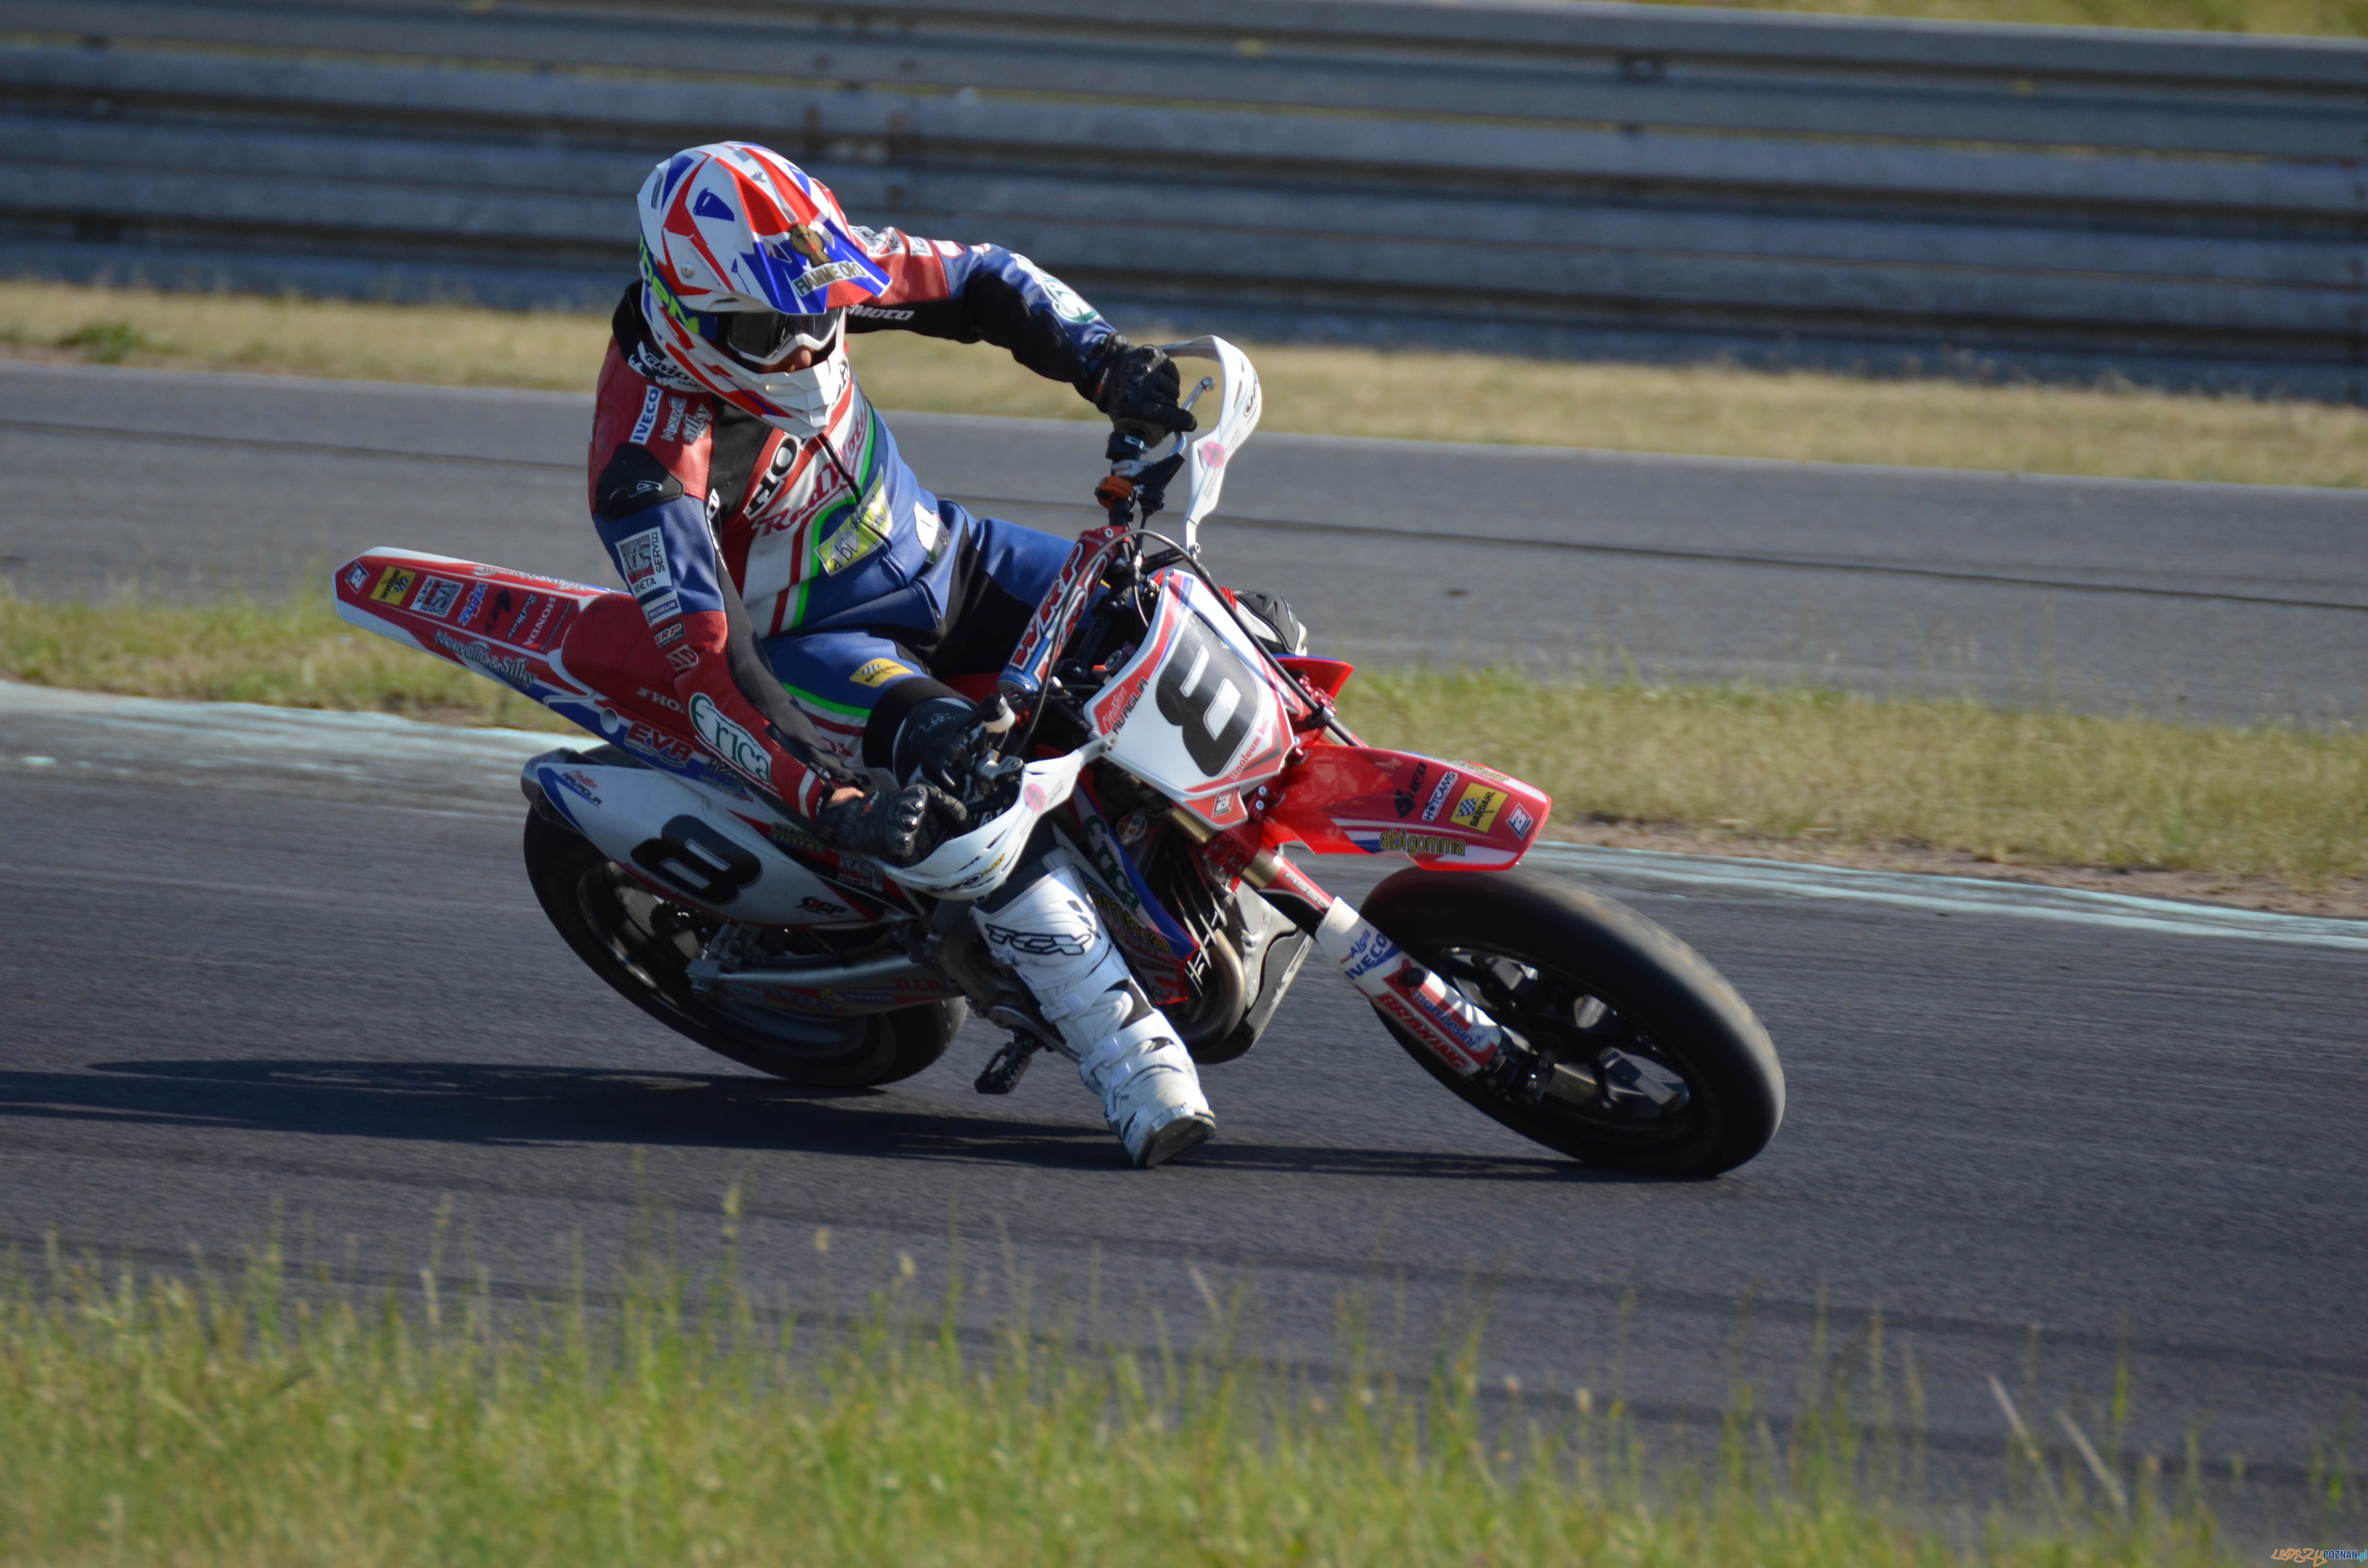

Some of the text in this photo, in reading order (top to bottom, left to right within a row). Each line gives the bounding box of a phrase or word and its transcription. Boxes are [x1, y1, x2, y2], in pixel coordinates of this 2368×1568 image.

[794, 265, 842, 295] FIAMME
[632, 388, 659, 441] IVECO
[747, 436, 805, 519] HO
[651, 531, 666, 573] SERVIZI
[522, 596, 557, 646] HONDA
[649, 600, 678, 618] MICHELIN
[1009, 541, 1085, 671] WRP
[434, 628, 490, 668] Nouvelle
[489, 656, 500, 670] &
[500, 656, 538, 687] Silky
[1155, 609, 1263, 778] 8
[626, 722, 693, 763] EVR
[1228, 736, 1261, 781] linoleum
[1423, 771, 1455, 820] HOTCAMS
[1469, 790, 1495, 827] BARDAHL
[630, 815, 763, 906] 8
[1380, 828, 1466, 856] abi gomma
[984, 923, 1092, 956] TCX
[1345, 933, 1388, 980] IVECO
[1350, 929, 1371, 958] Algis
[892, 978, 942, 991] DID
[1414, 991, 1478, 1049] marchesini
